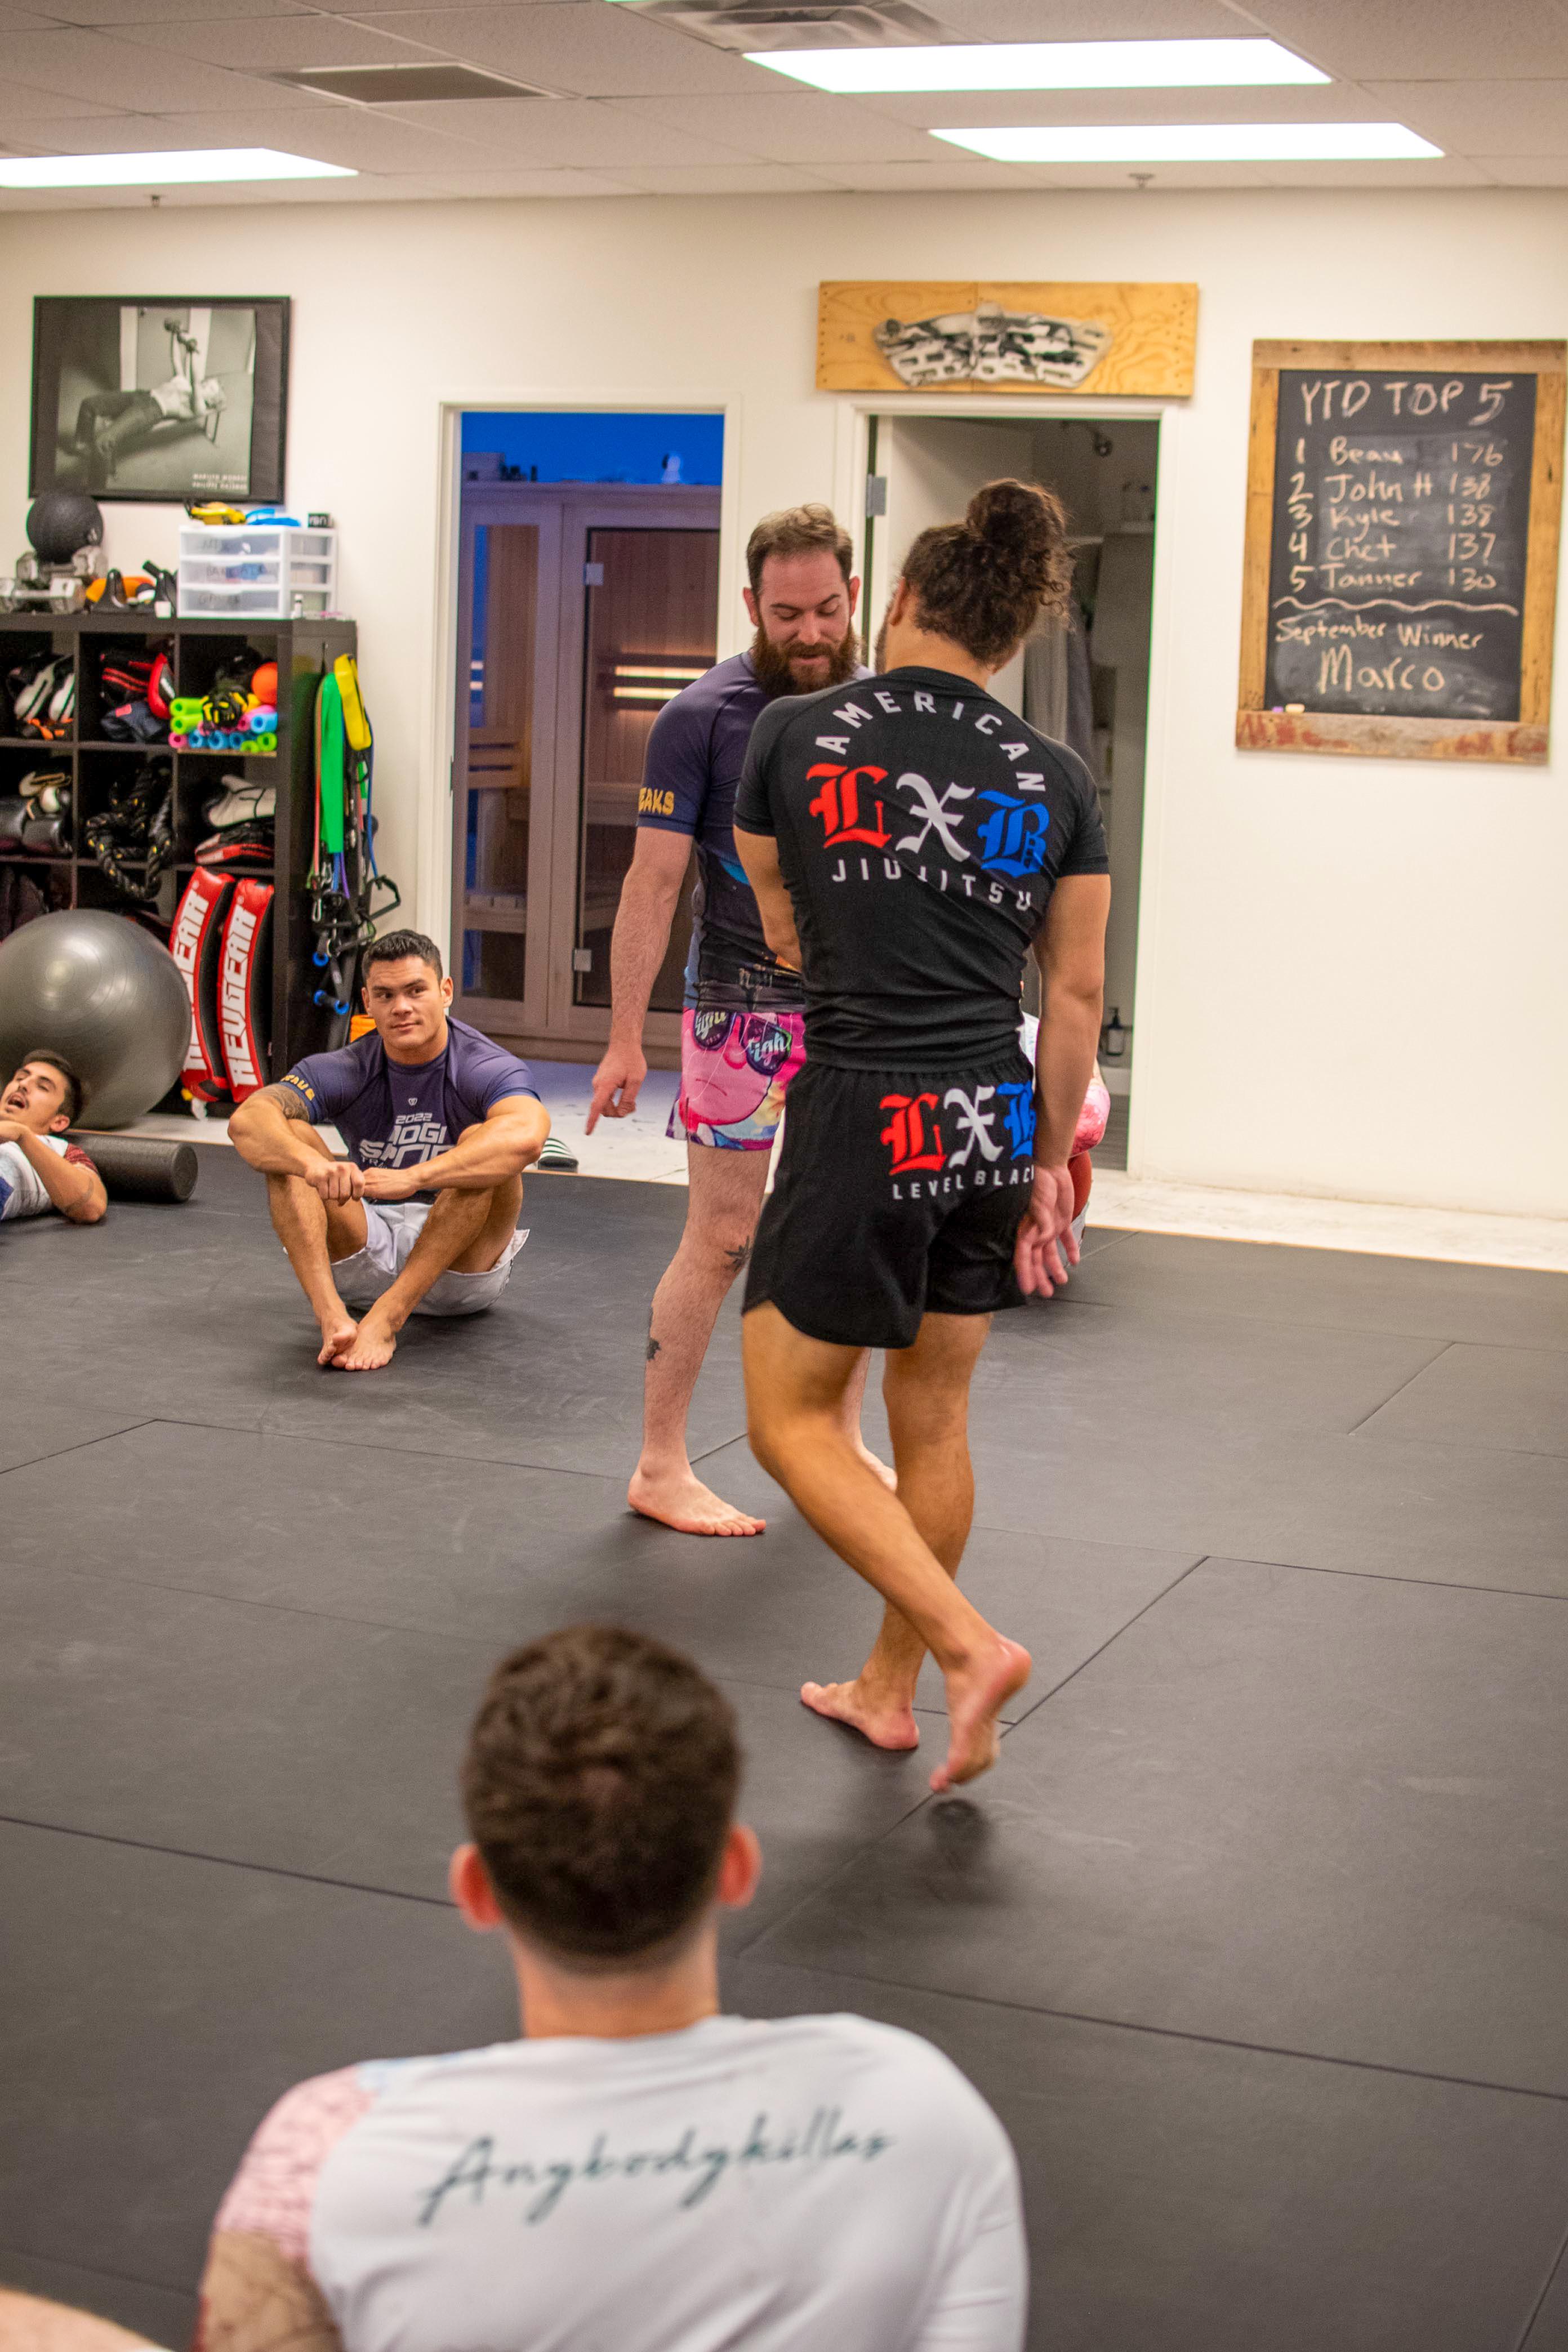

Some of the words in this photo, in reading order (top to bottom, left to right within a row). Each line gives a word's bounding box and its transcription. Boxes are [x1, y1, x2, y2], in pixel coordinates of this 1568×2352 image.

[1301, 380, 1371, 426] YTD
[1383, 380, 1465, 416] TOP
[1468, 380, 1514, 426] 5
[1295, 437, 1306, 465] 1
[1451, 442, 1504, 467] 176
[1288, 471, 1315, 504] 2
[1324, 469, 1404, 504] John
[1413, 471, 1433, 499] H
[1448, 471, 1492, 501] 138
[1288, 504, 1314, 530] 3
[1329, 506, 1401, 544] Kyle
[1288, 531, 1308, 562] 4
[1326, 534, 1397, 562] Chet
[1448, 532, 1497, 561] 137
[1289, 565, 1316, 593] 5
[1319, 563, 1423, 591] Tanner
[1448, 567, 1497, 592] 130
[1275, 609, 1387, 647] September
[1397, 622, 1485, 650] Winner
[1318, 643, 1446, 694] Marco
[814, 691, 1046, 792] AMERICAN
[395, 1112, 433, 1125] 2022
[893, 1174, 964, 1200] LEVEL
